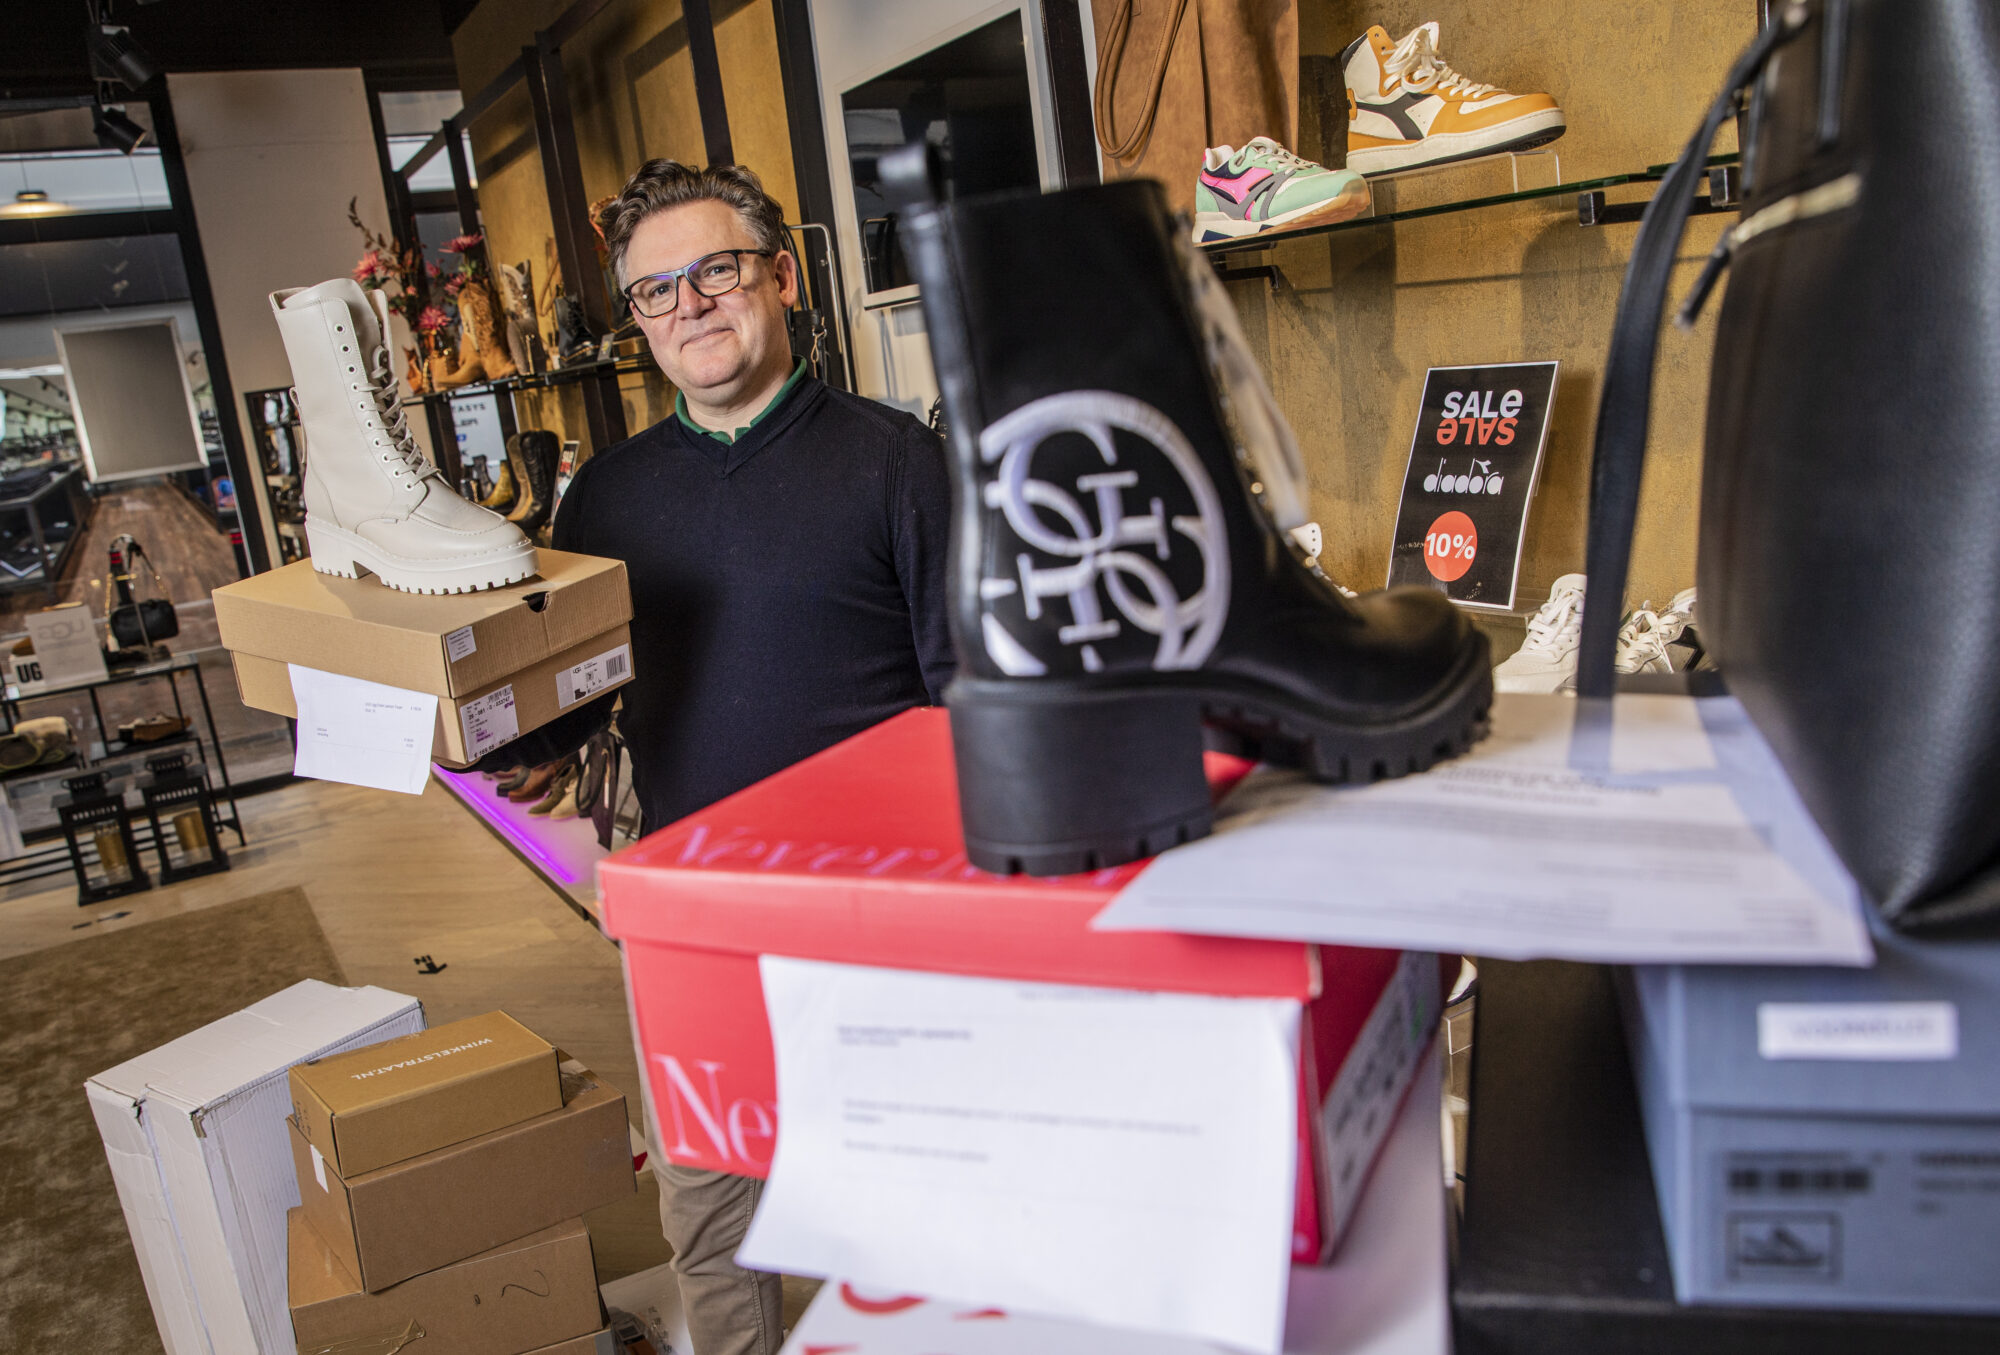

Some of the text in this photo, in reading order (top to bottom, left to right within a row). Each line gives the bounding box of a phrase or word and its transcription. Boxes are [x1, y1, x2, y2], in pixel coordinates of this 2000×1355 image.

[1423, 457, 1504, 495] diadora
[1426, 532, 1475, 560] 10%
[15, 662, 44, 684] UG
[351, 1037, 493, 1081] WINKELSTRAAT.NL
[650, 1052, 777, 1173] Ne
